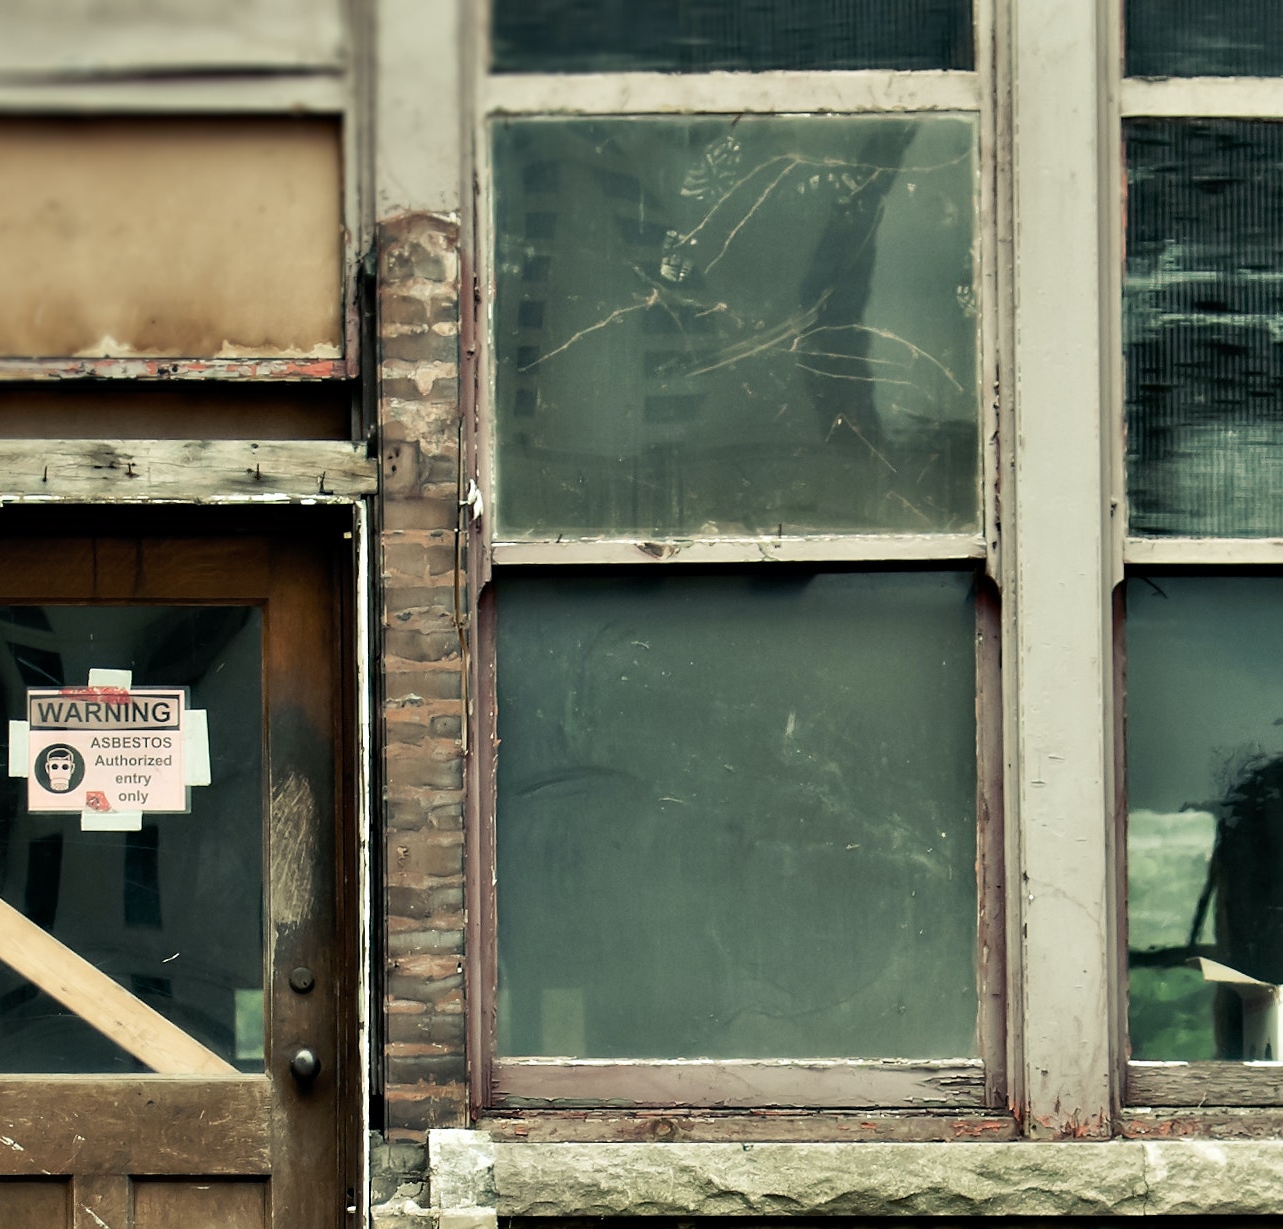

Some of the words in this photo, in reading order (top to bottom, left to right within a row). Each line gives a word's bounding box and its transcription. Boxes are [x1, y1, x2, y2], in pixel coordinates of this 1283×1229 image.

[37, 702, 171, 723] WARNING
[90, 736, 173, 749] ASBESTOS
[94, 754, 173, 766] Authorized
[115, 774, 152, 786] entry
[118, 789, 149, 804] only
